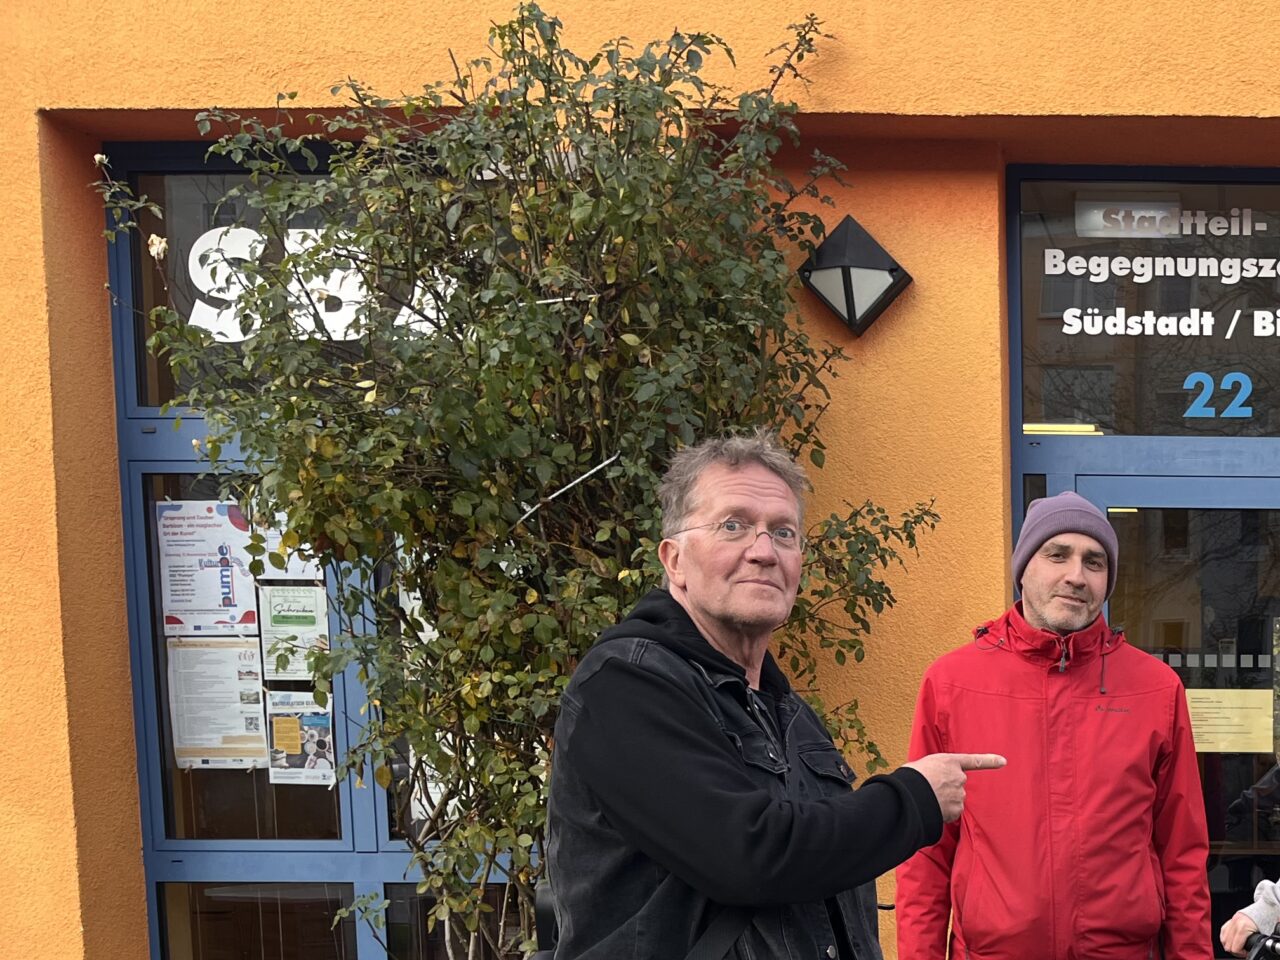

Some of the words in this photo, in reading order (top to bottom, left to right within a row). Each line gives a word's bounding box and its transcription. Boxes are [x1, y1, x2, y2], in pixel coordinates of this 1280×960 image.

[1101, 208, 1268, 237] Stadtteil-
[1061, 307, 1215, 337] Südstadt
[1224, 309, 1241, 340] /
[1182, 371, 1254, 419] 22
